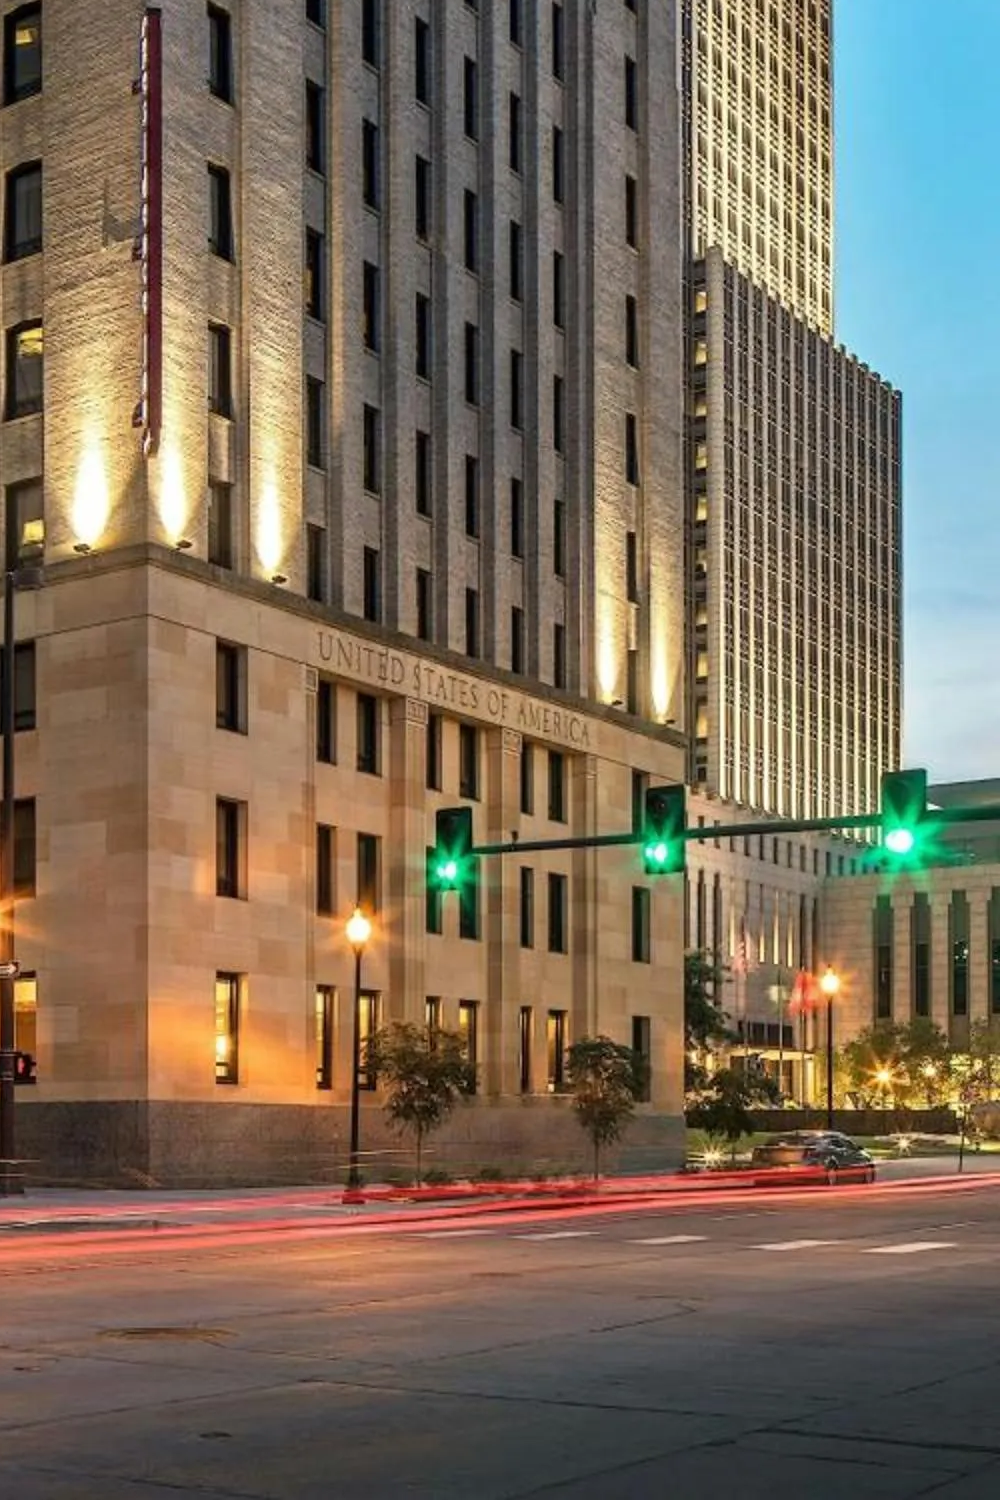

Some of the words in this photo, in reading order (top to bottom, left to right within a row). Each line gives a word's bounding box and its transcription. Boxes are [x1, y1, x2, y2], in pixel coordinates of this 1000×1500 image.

[317, 631, 405, 685] UNITED
[413, 661, 479, 708] STATES
[488, 690, 509, 719] OF
[518, 704, 590, 747] AMERICA
